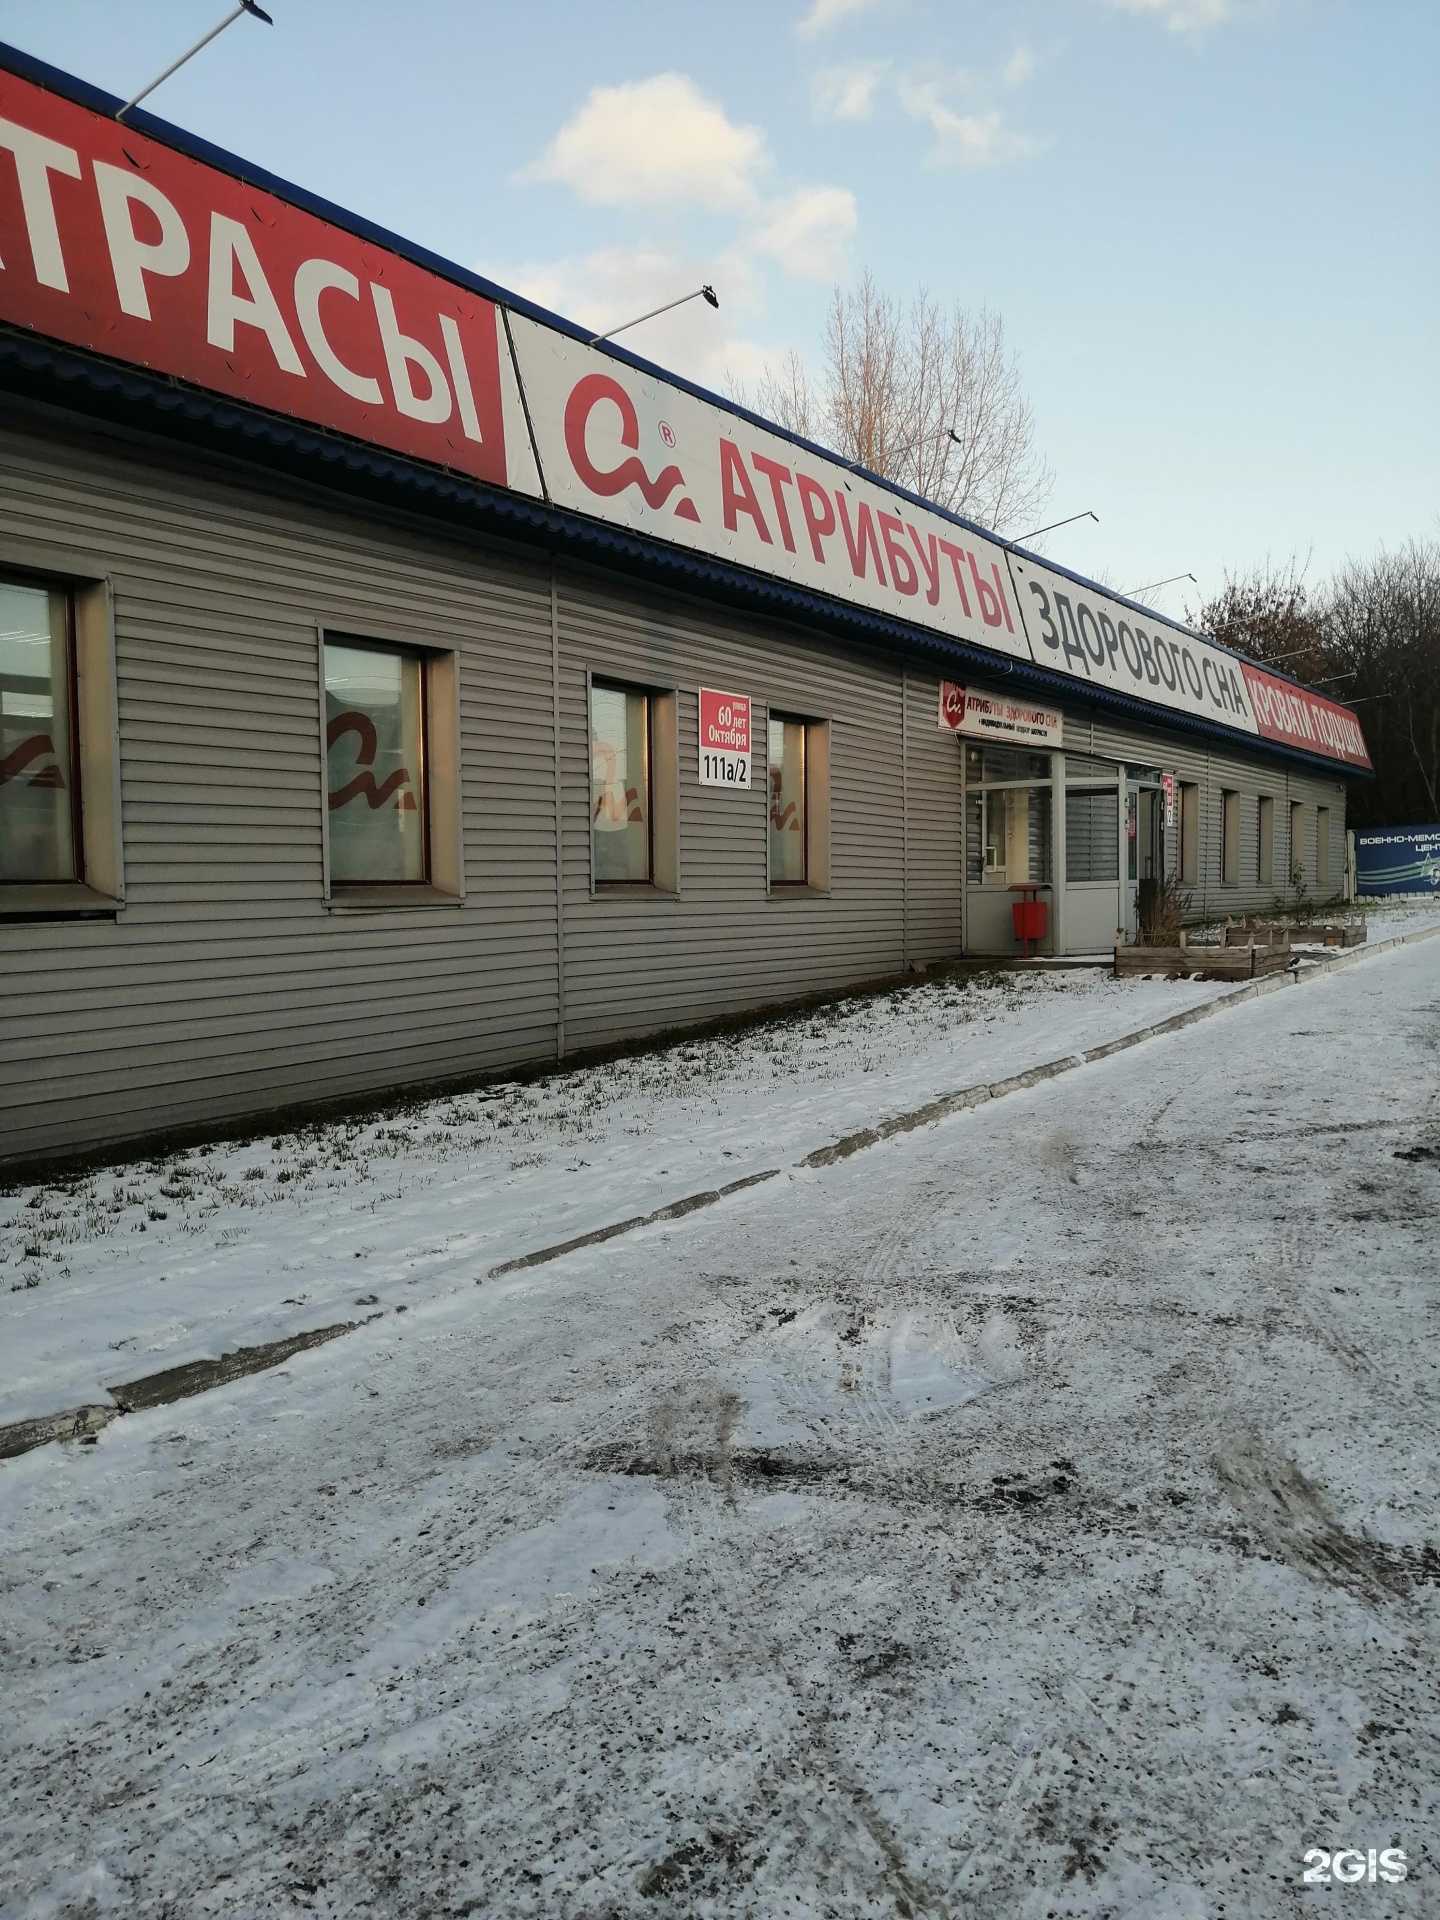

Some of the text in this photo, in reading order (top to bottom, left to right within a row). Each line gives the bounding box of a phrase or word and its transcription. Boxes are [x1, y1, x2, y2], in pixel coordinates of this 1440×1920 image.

[0, 117, 483, 444] ТРАСЫ
[719, 437, 1249, 718] АТРИБУТЫ ЗДОРОВОГО СНА
[718, 706, 747, 729] 60 лет
[708, 725, 747, 749] Октября
[704, 755, 747, 783] 111а/2
